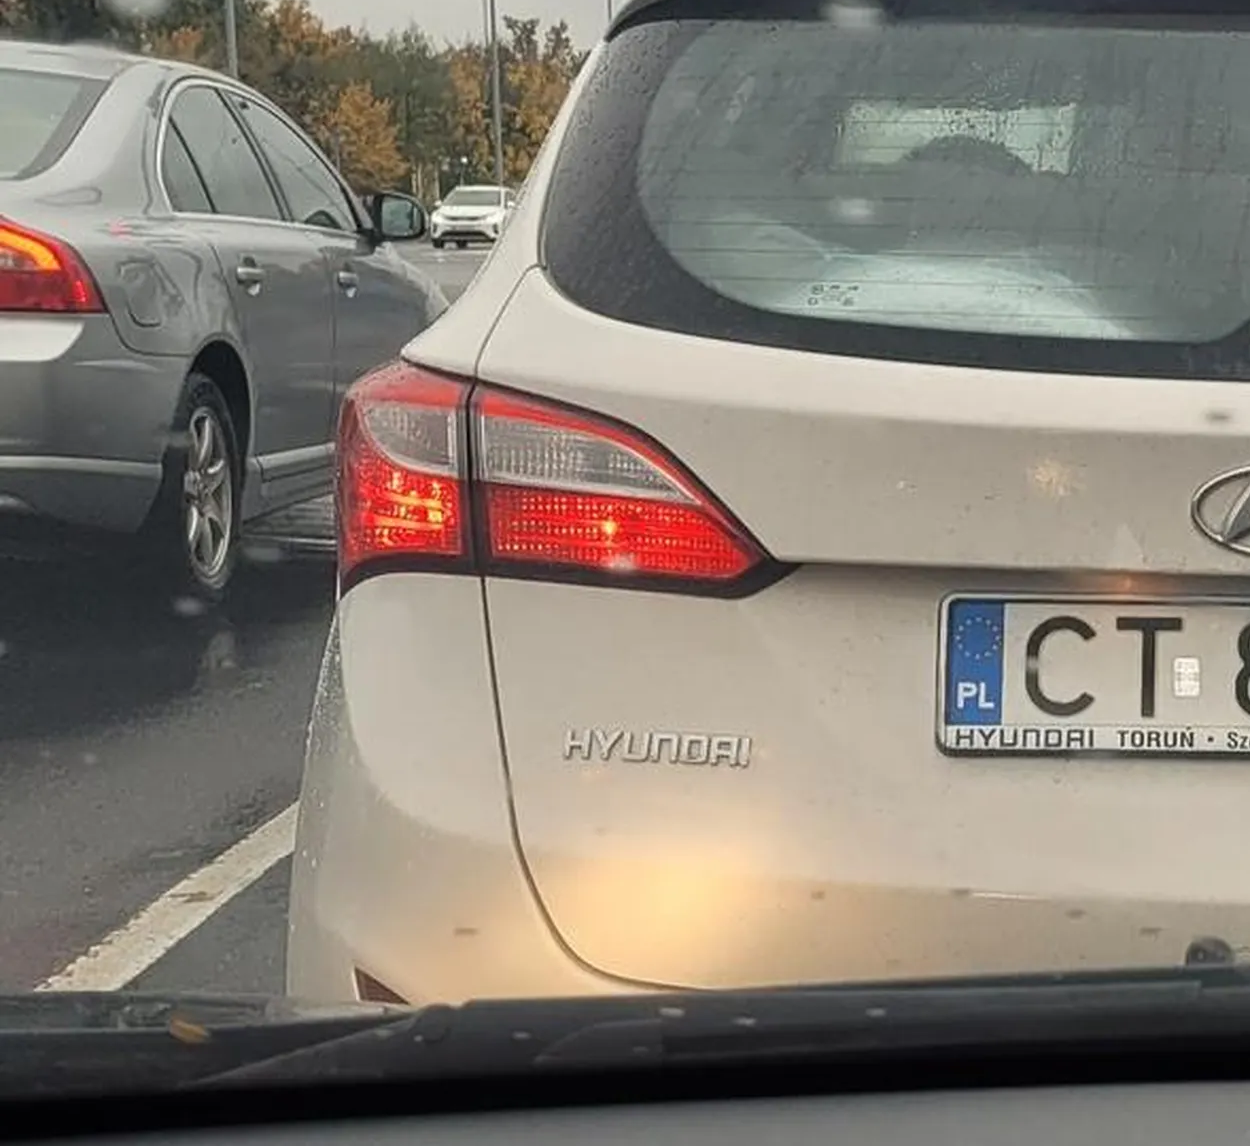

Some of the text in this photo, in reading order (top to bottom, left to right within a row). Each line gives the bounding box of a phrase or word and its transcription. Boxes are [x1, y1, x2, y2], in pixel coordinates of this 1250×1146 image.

[1024, 615, 1183, 718] CT
[957, 682, 995, 709] PL
[563, 728, 752, 768] HYUNDAI
[955, 728, 1094, 748] HYUNDAI
[1117, 726, 1195, 749] TORUŃ
